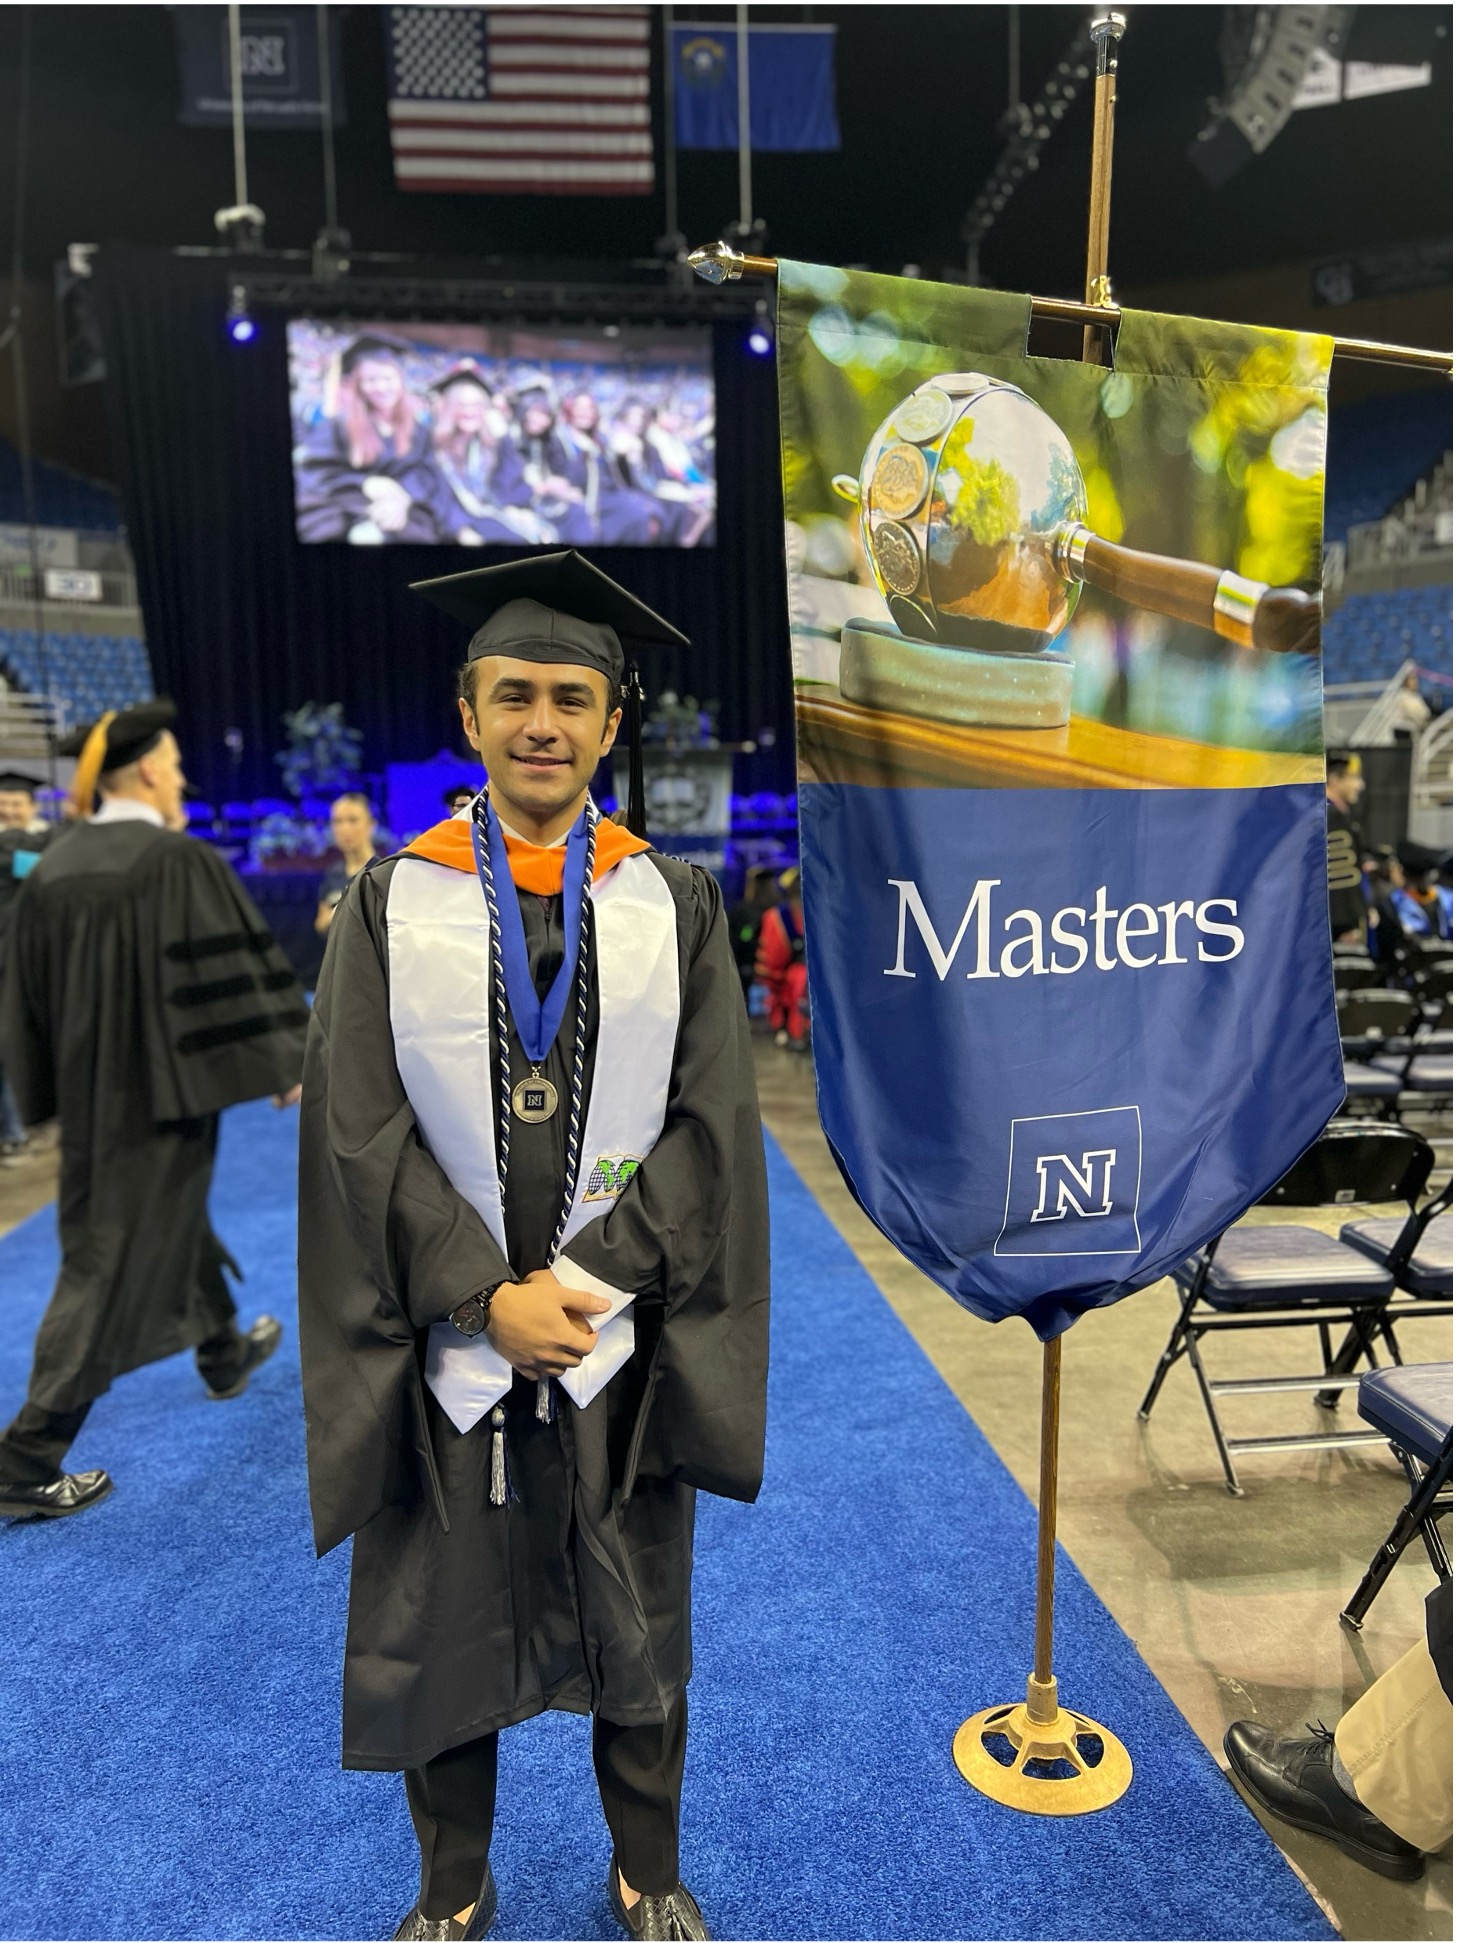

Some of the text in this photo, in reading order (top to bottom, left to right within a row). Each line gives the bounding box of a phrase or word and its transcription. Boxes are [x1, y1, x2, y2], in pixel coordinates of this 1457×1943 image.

[883, 879, 1245, 982] Masters
[527, 1094, 542, 1106] N
[1030, 1148, 1117, 1223] N
